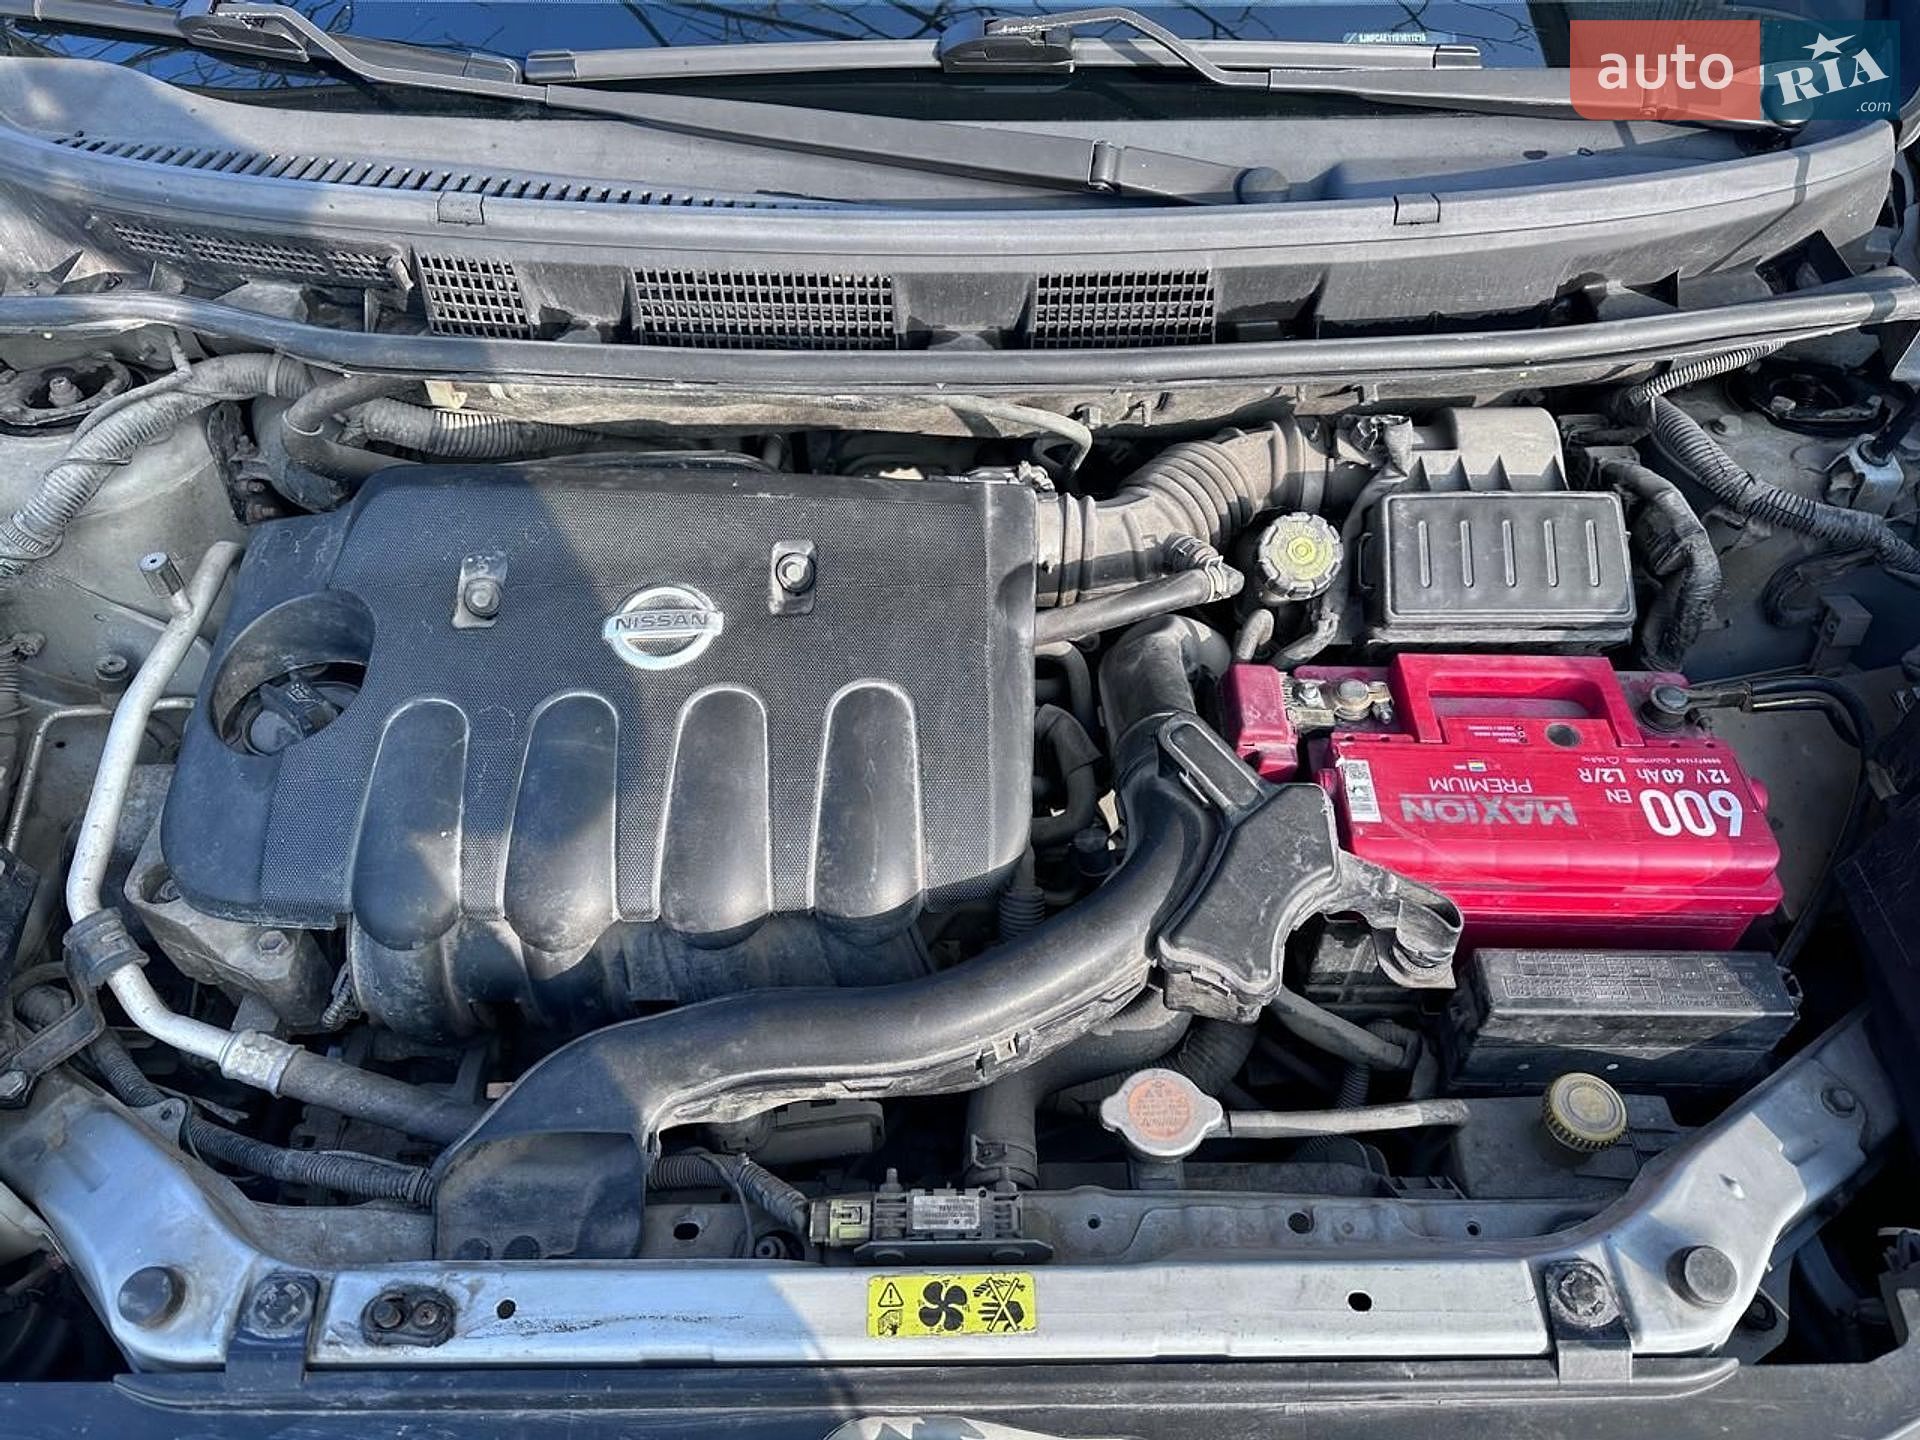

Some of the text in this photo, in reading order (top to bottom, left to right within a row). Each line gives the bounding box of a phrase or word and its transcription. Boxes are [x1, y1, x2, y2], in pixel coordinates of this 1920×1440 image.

[615, 613, 708, 630] NISSAN
[1636, 768, 1685, 784] 60Ah
[1429, 777, 1533, 794] PREMIUM
[1399, 795, 1579, 826] MAXION
[1604, 788, 1743, 837] 600 EN
